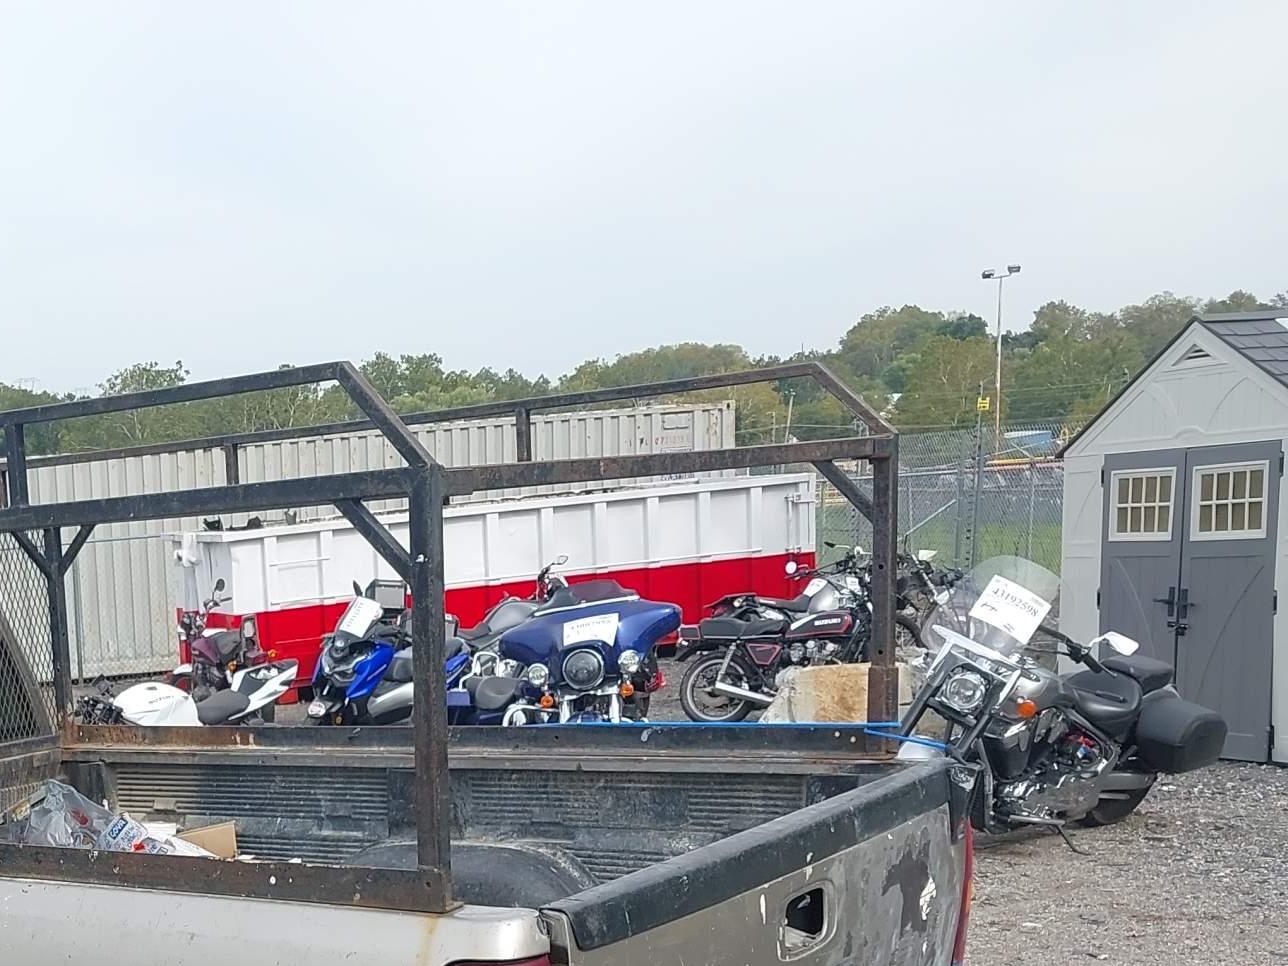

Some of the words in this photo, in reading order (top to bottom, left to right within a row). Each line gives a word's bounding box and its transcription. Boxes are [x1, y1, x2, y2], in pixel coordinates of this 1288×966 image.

[991, 587, 1039, 617] 43192598
[814, 617, 842, 627] SUZUKI
[109, 818, 127, 839] GOYA
